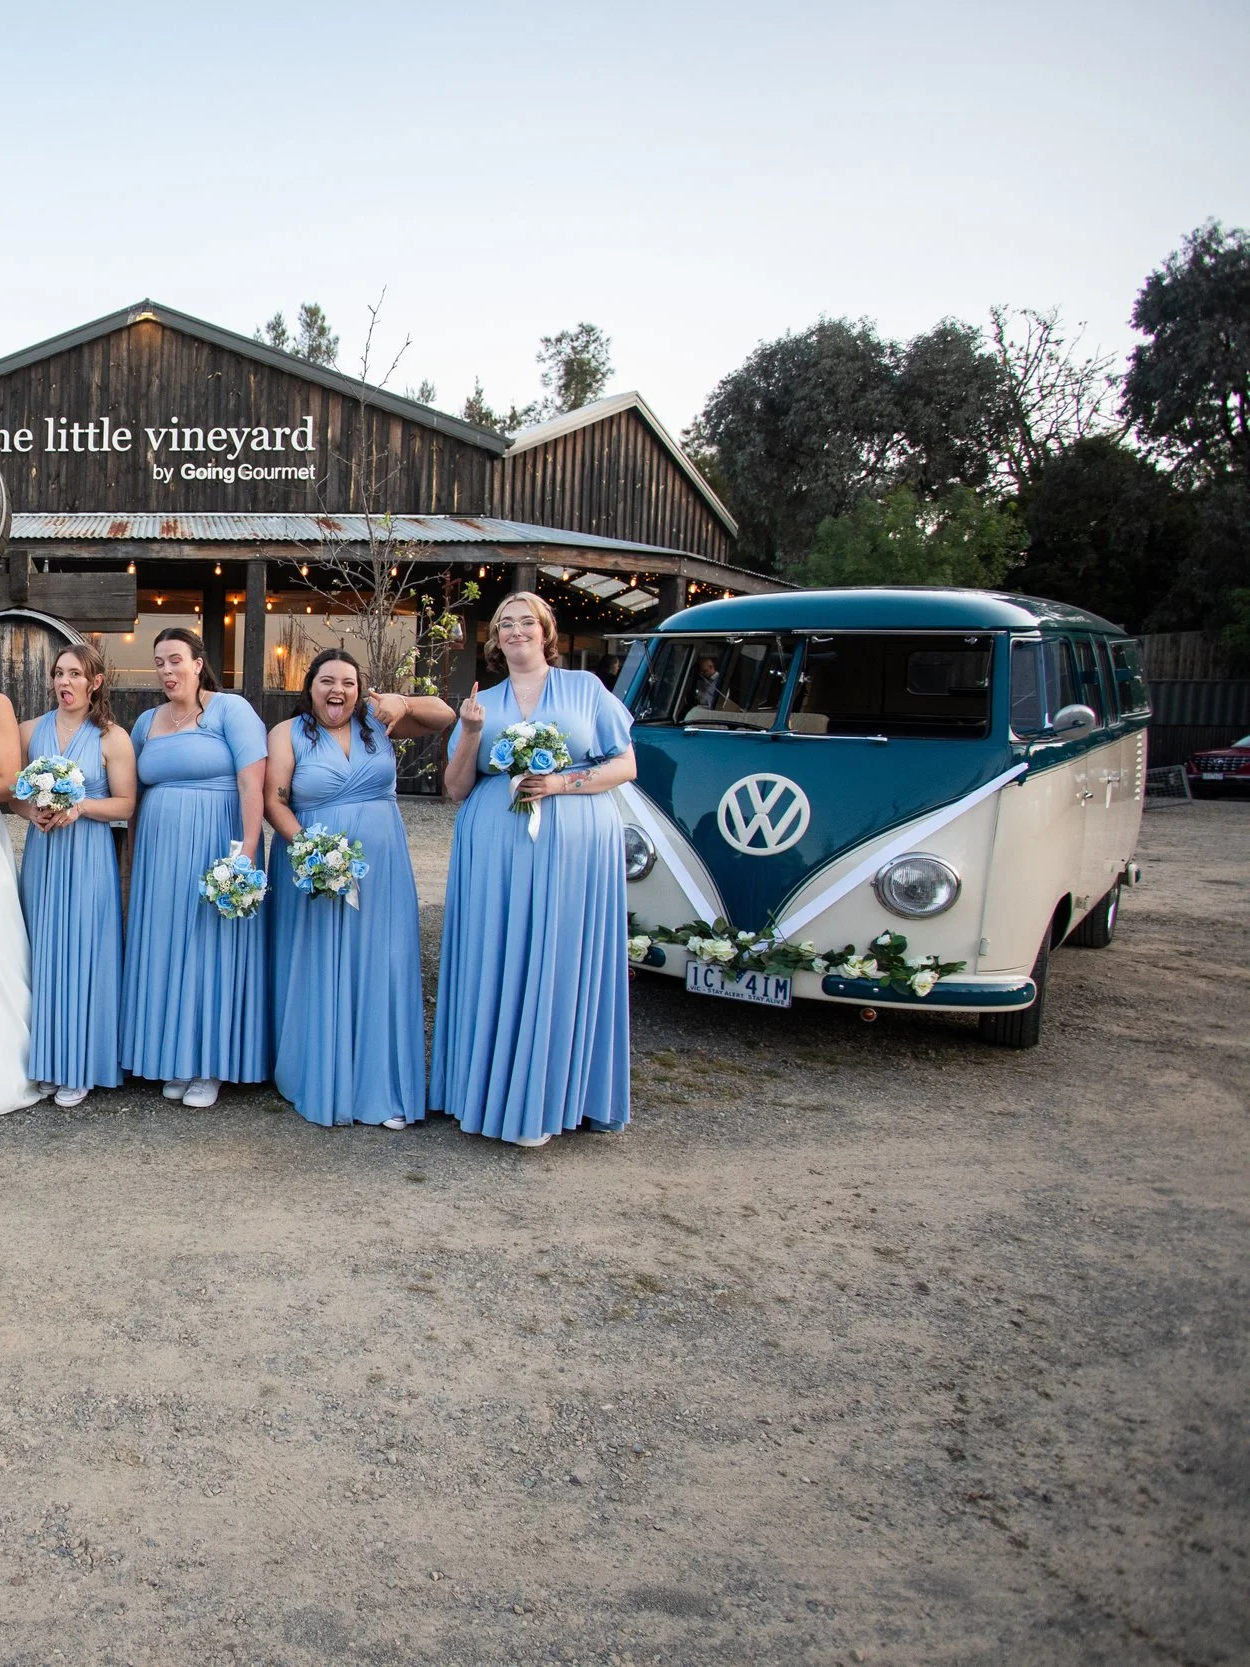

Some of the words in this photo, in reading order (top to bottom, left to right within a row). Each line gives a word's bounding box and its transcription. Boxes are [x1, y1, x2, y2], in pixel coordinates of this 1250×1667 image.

[44, 417, 133, 452] little
[144, 416, 316, 460] vineyard
[152, 464, 174, 484] by
